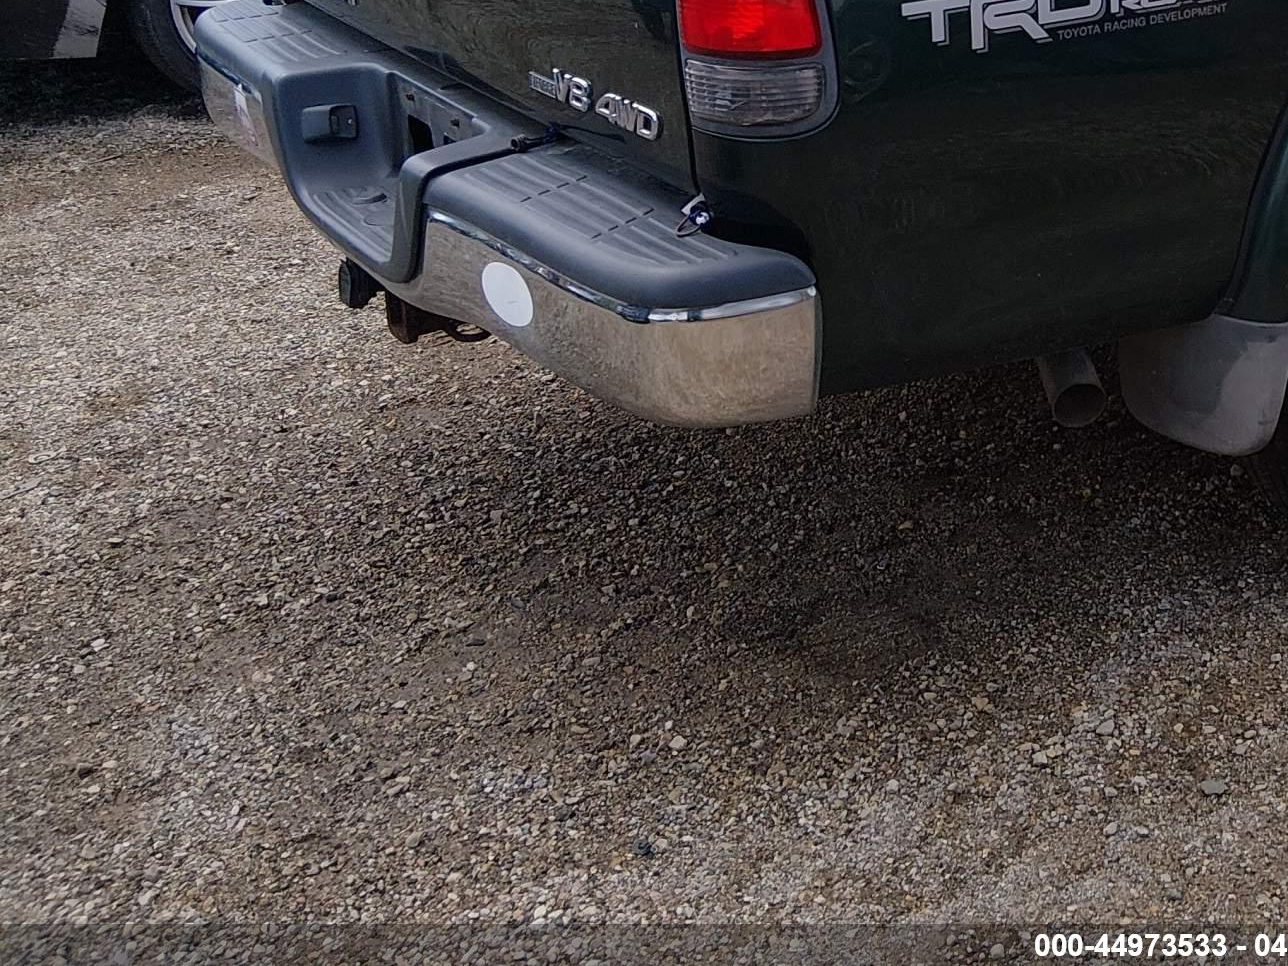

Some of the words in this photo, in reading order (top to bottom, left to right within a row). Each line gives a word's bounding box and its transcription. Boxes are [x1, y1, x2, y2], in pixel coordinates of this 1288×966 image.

[1057, 23, 1101, 41] TOYOTA
[1104, 16, 1146, 32] RACING
[1149, 3, 1228, 25] DEVELOPMENT
[552, 68, 590, 113] V8
[595, 92, 661, 141] 4WD
